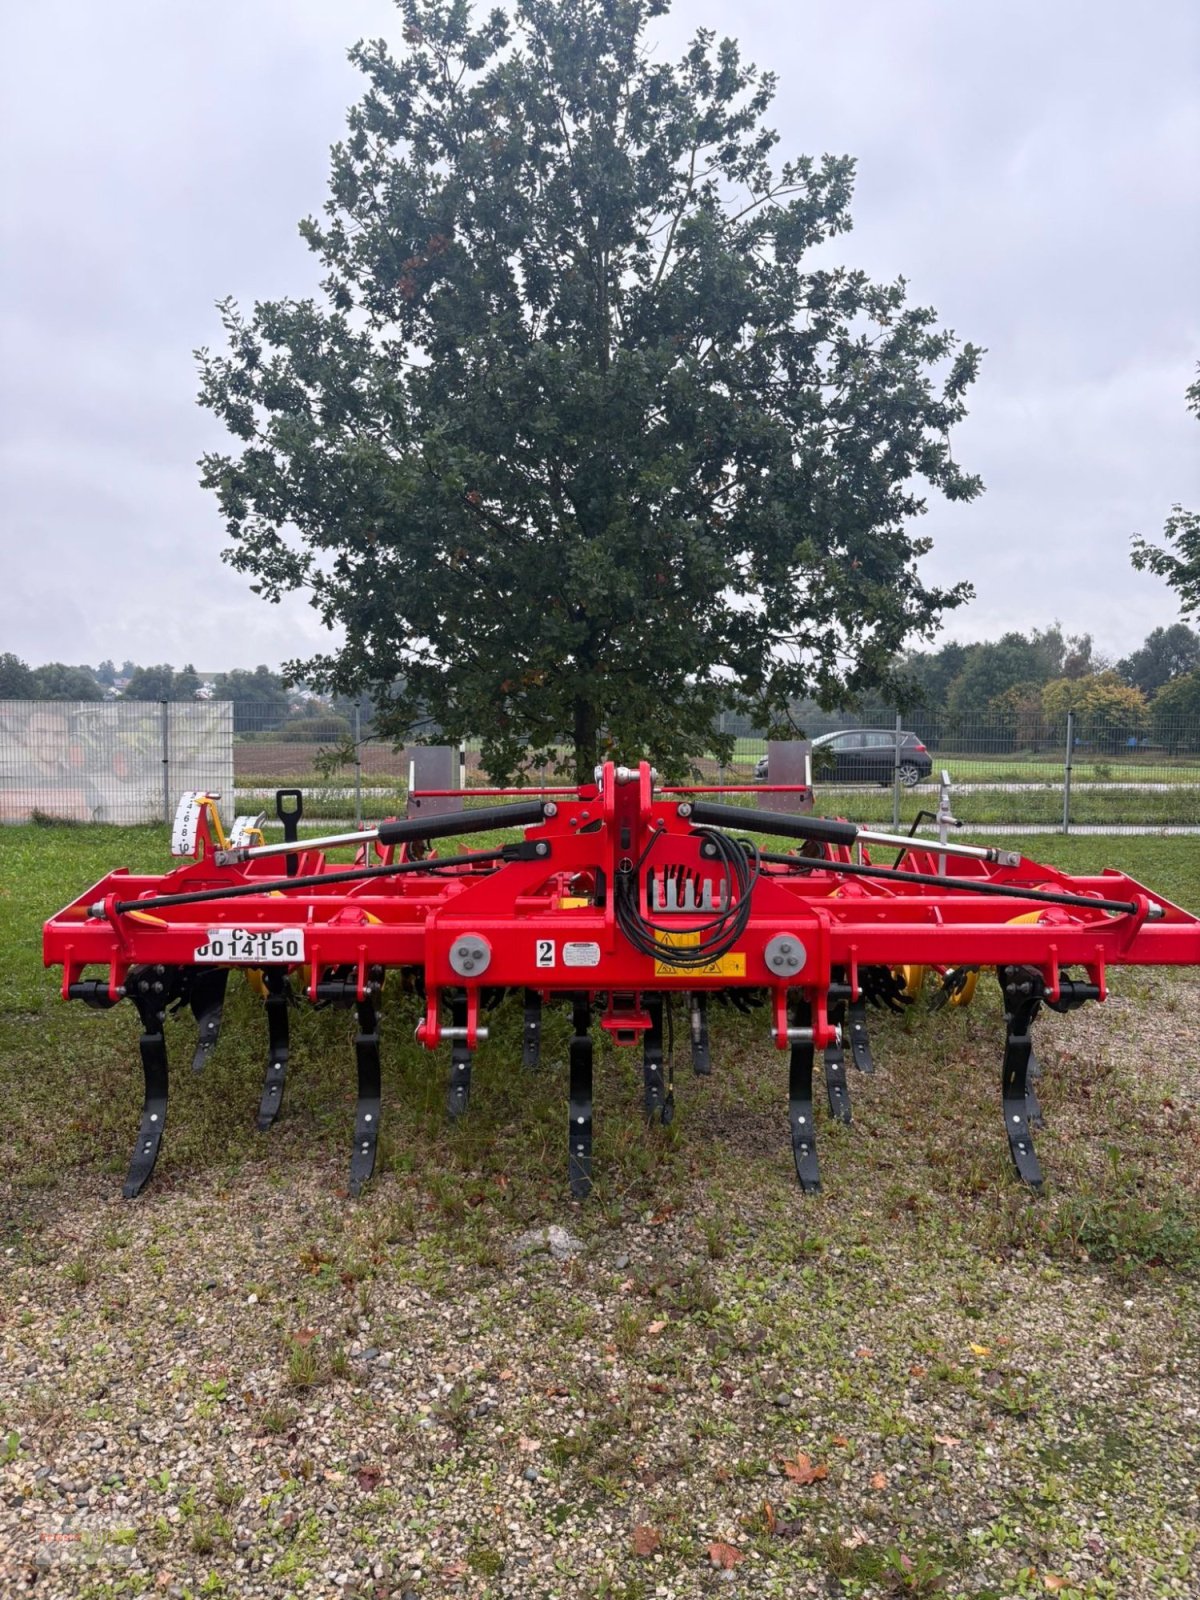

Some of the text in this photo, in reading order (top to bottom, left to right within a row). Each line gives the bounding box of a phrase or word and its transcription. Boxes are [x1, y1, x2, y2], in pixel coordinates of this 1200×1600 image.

[183, 815, 190, 823] 6
[181, 828, 188, 837] 8
[178, 843, 190, 853] 10
[539, 941, 553, 962] 2
